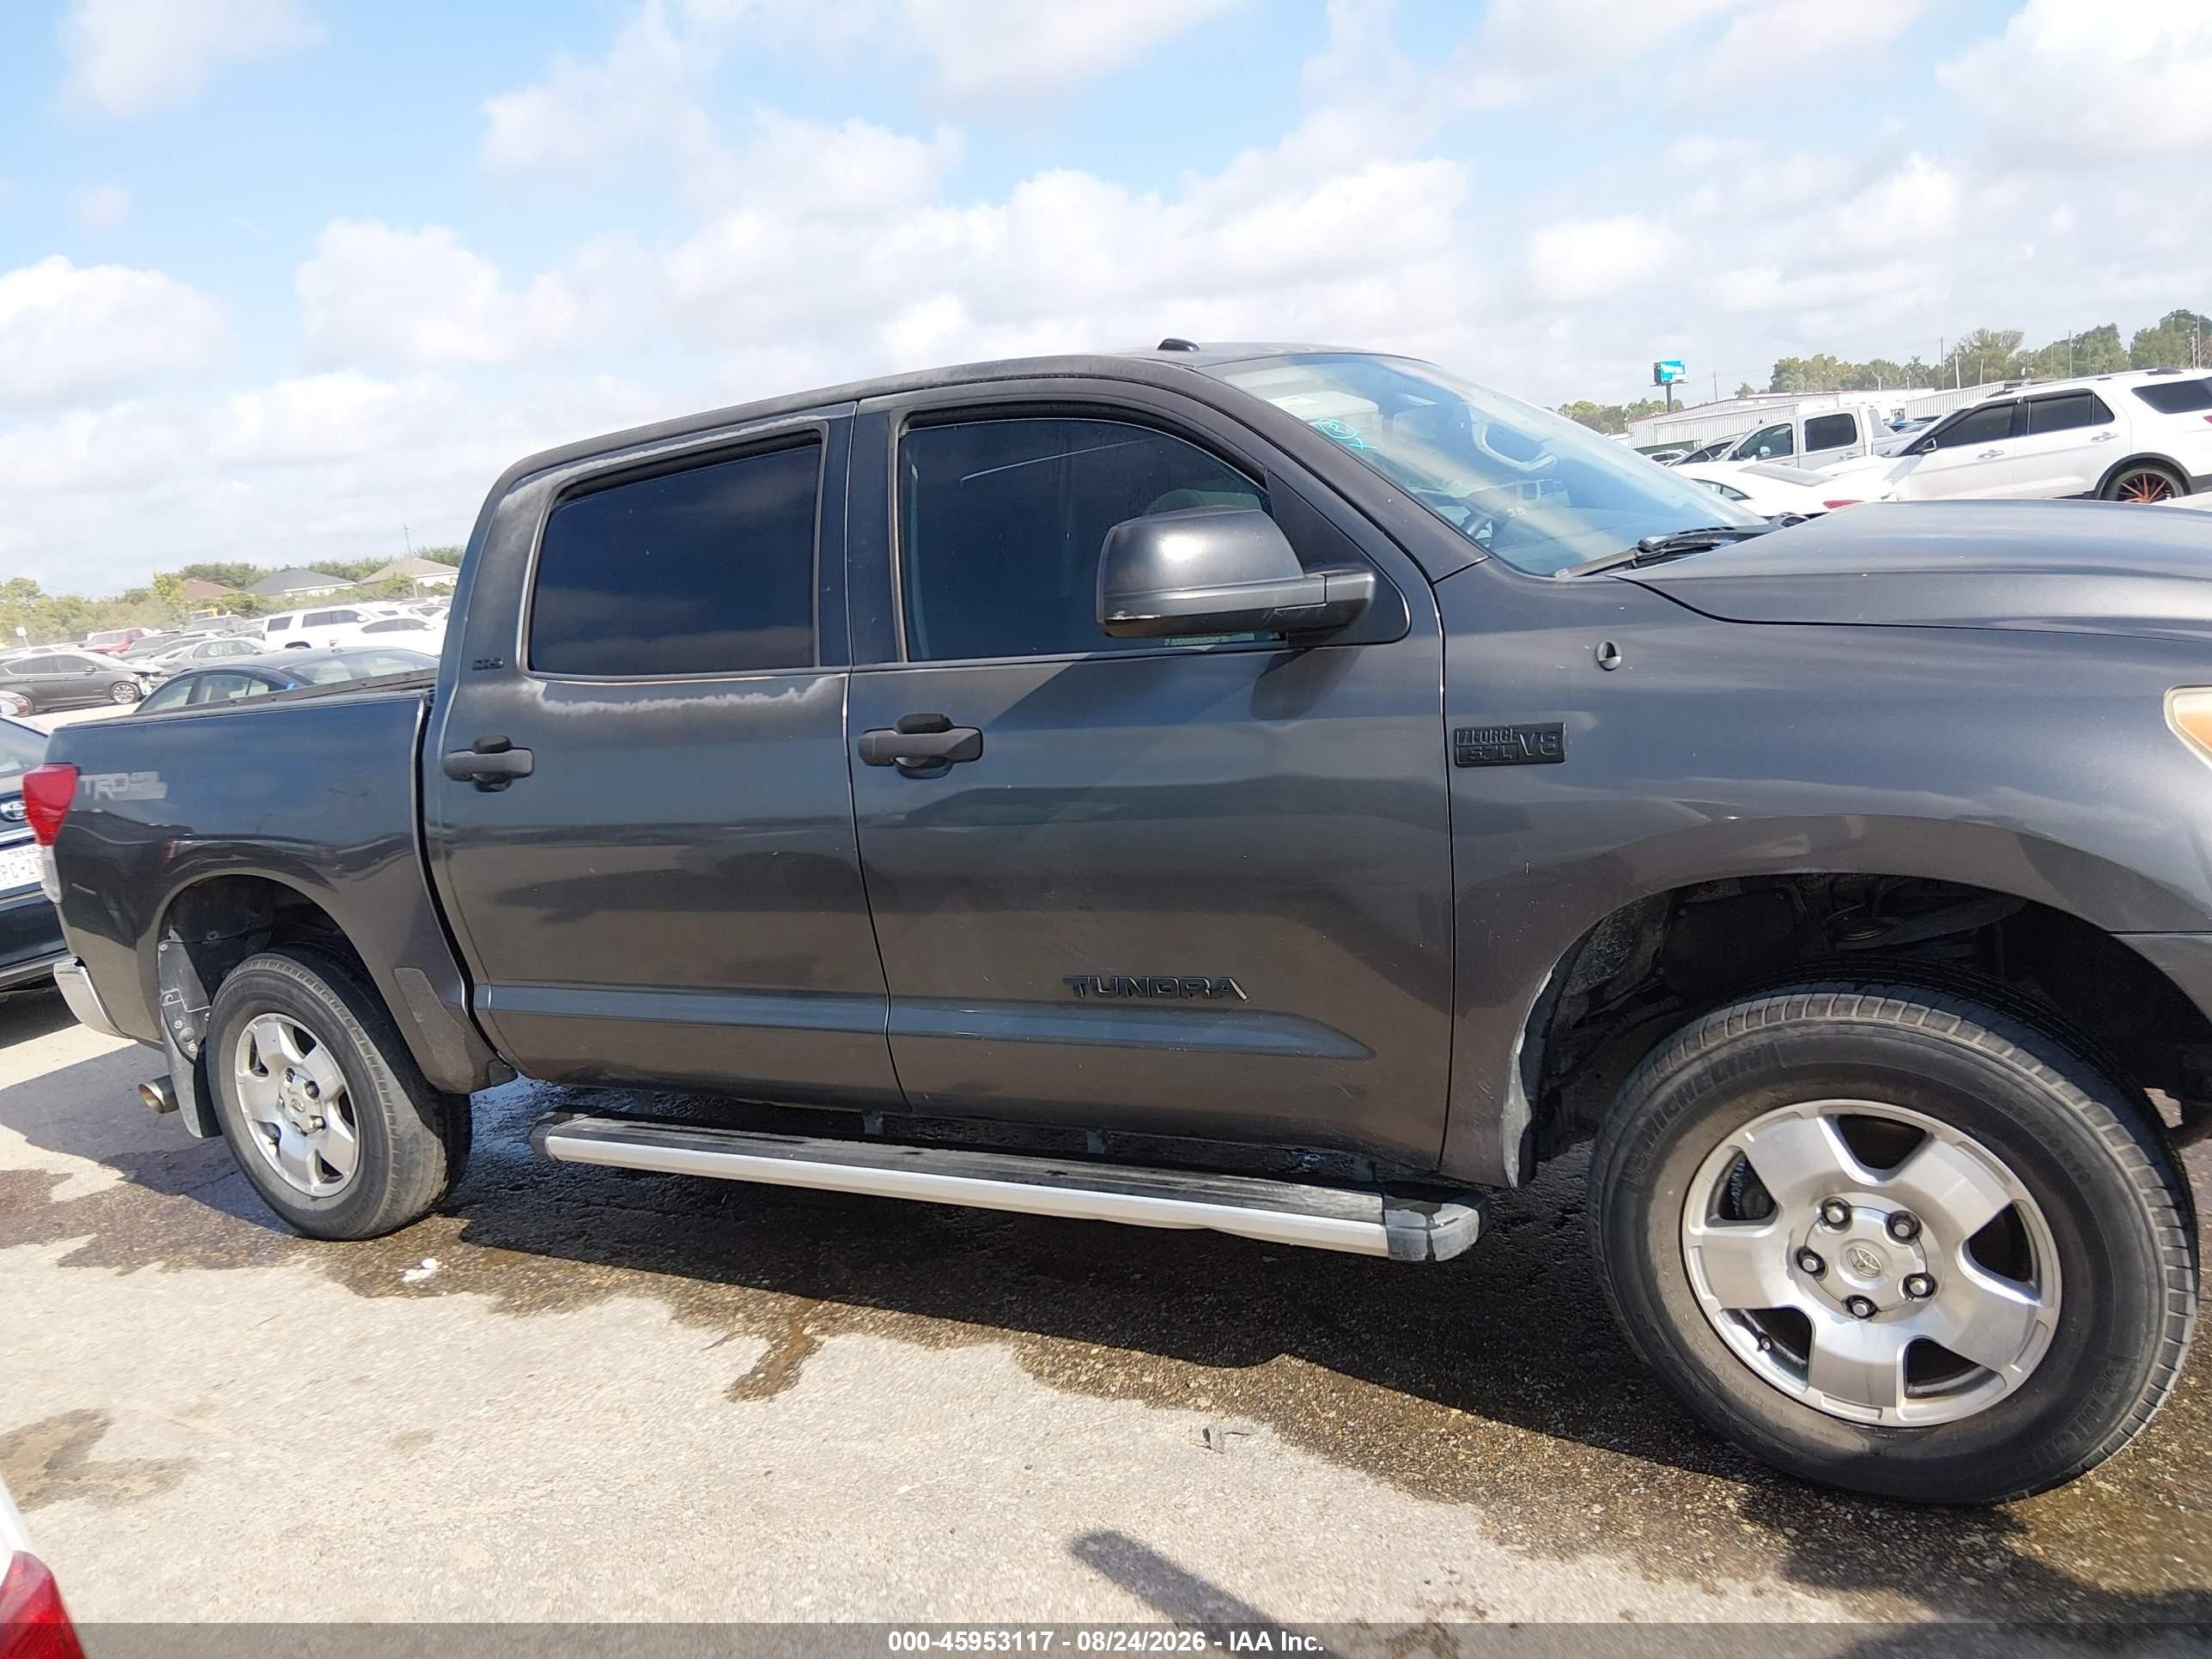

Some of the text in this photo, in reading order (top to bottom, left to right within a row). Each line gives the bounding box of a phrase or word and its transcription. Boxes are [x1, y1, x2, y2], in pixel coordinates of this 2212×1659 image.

[1518, 730, 1561, 757] V8
[78, 773, 131, 801] TRD
[1062, 975, 1250, 1002] TUNDRA
